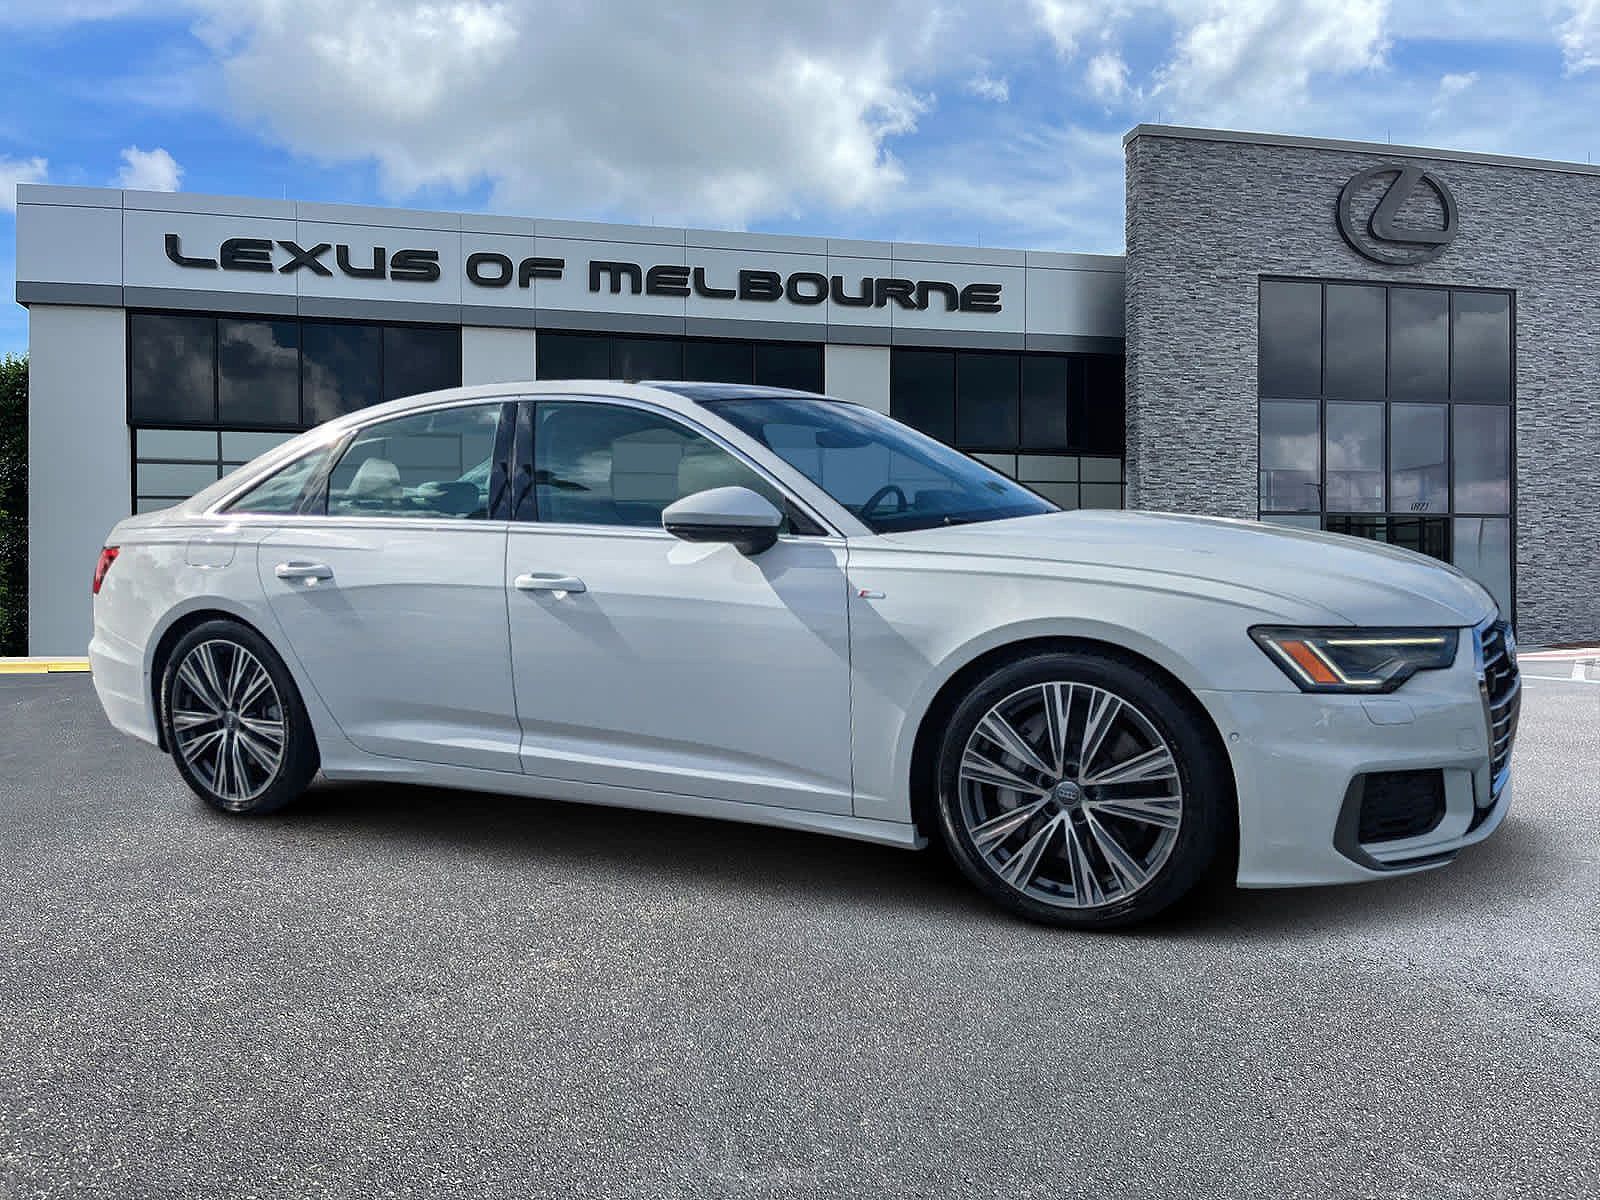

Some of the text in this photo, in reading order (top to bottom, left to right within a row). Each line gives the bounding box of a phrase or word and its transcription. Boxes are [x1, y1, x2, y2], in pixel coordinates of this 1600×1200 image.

[164, 233, 1003, 314] LEXUS OF MELBOURNE
